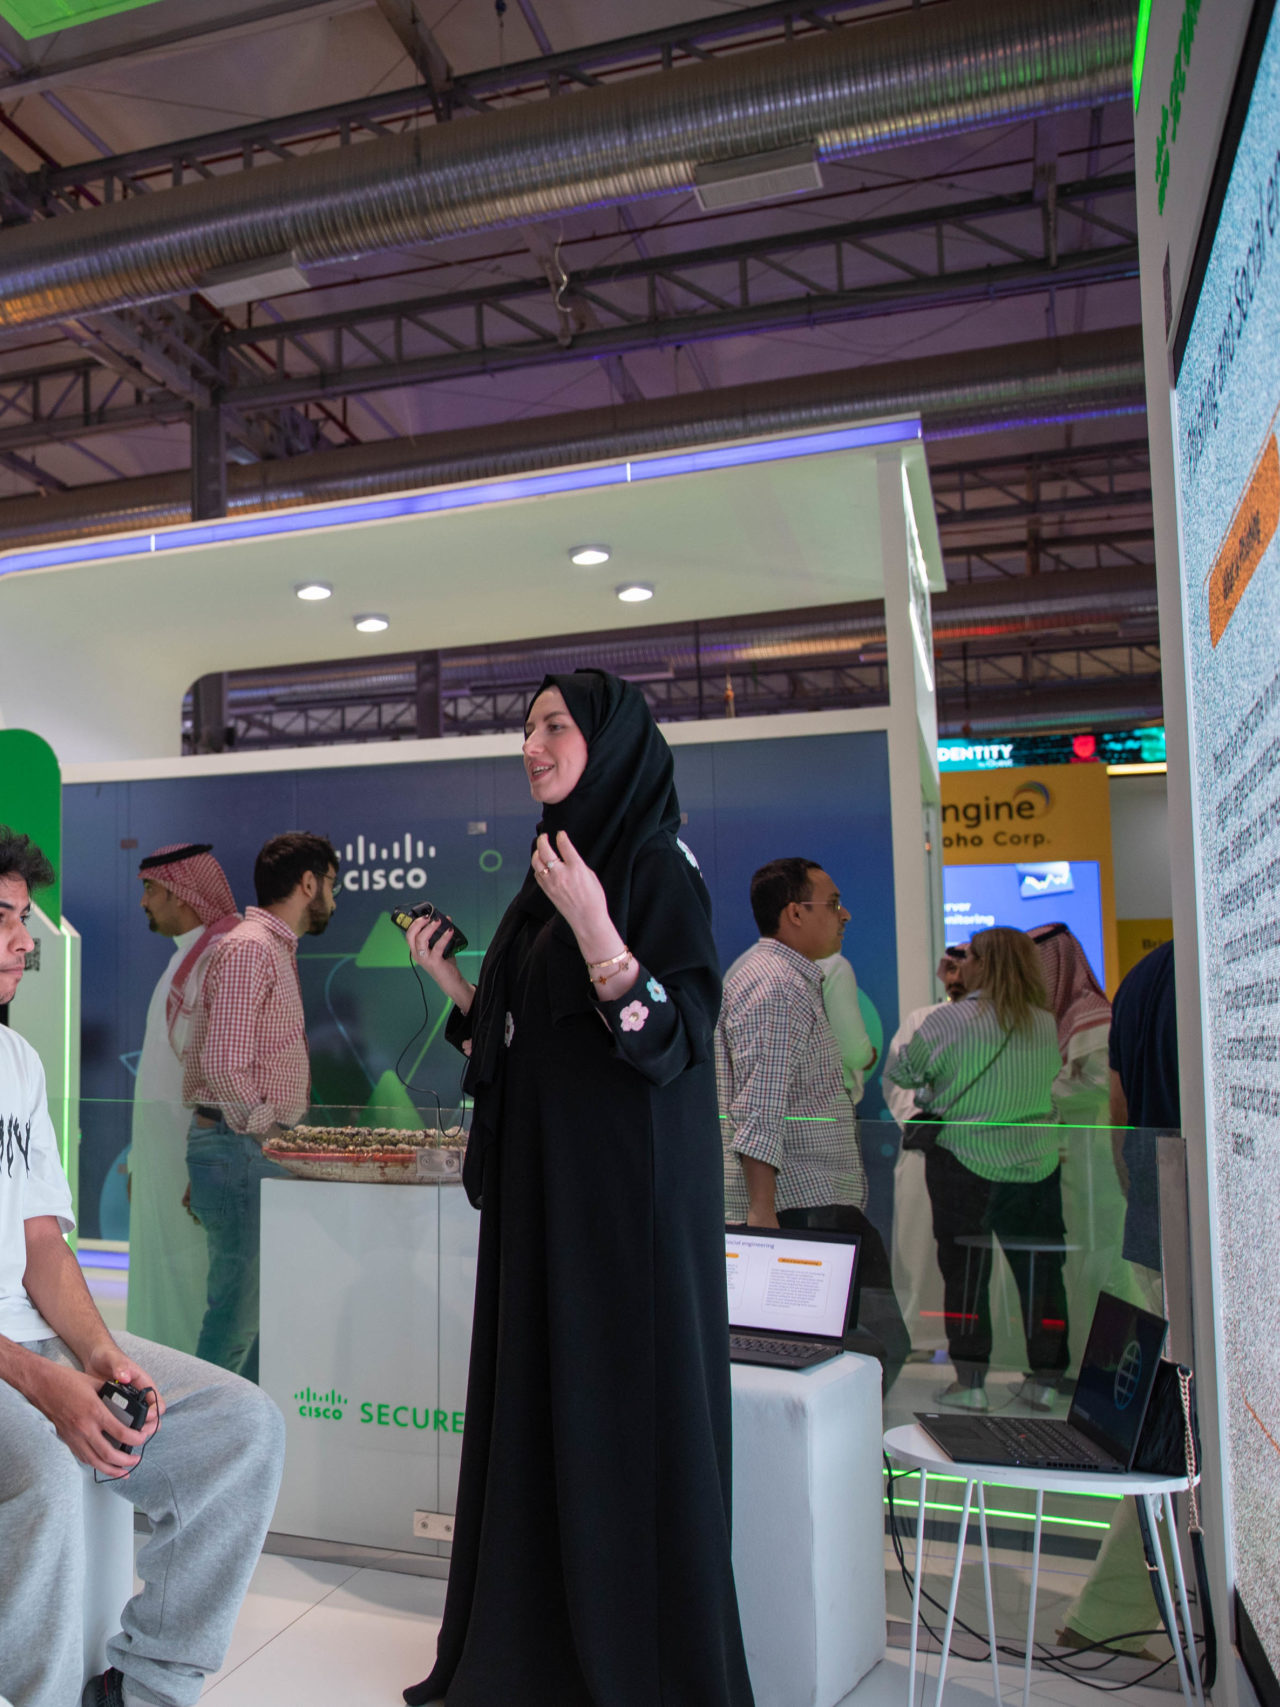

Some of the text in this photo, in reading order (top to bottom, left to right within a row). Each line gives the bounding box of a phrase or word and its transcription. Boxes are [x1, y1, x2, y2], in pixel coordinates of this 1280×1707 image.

[937, 744, 1013, 762] DENTITY
[941, 795, 1036, 829] ngine
[942, 831, 1052, 848] oho Corp.
[343, 867, 428, 892] CISCO
[298, 1401, 466, 1434] CISCO SECURE
